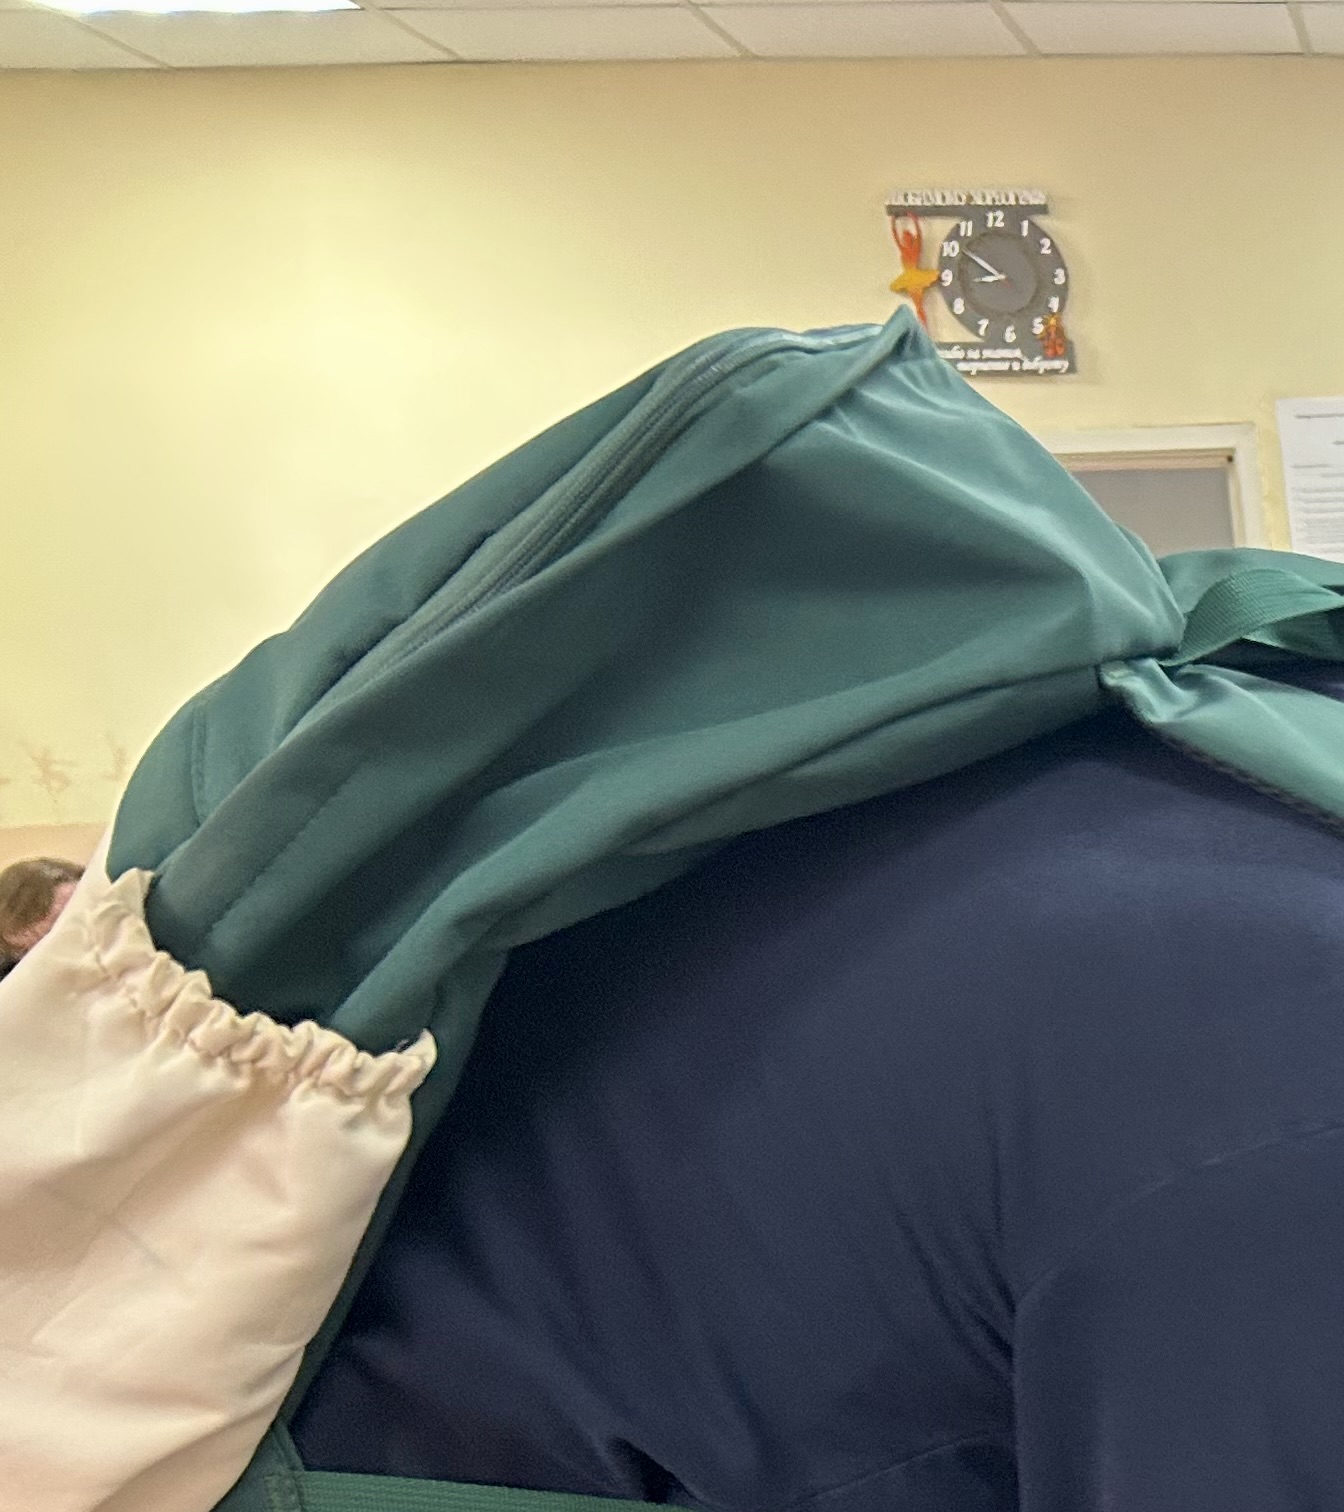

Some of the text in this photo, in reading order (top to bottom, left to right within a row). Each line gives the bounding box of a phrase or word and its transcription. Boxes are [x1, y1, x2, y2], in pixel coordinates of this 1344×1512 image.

[986, 210, 1005, 228] 12
[959, 220, 974, 237] 11
[1020, 219, 1029, 238] 1
[941, 240, 960, 258] 10
[1040, 237, 1052, 256] 2
[940, 269, 953, 287] 9
[1053, 268, 1066, 285] 3
[953, 297, 966, 315] 8
[977, 318, 990, 336] 7
[1004, 325, 1017, 343] 6
[1031, 317, 1045, 335] 5
